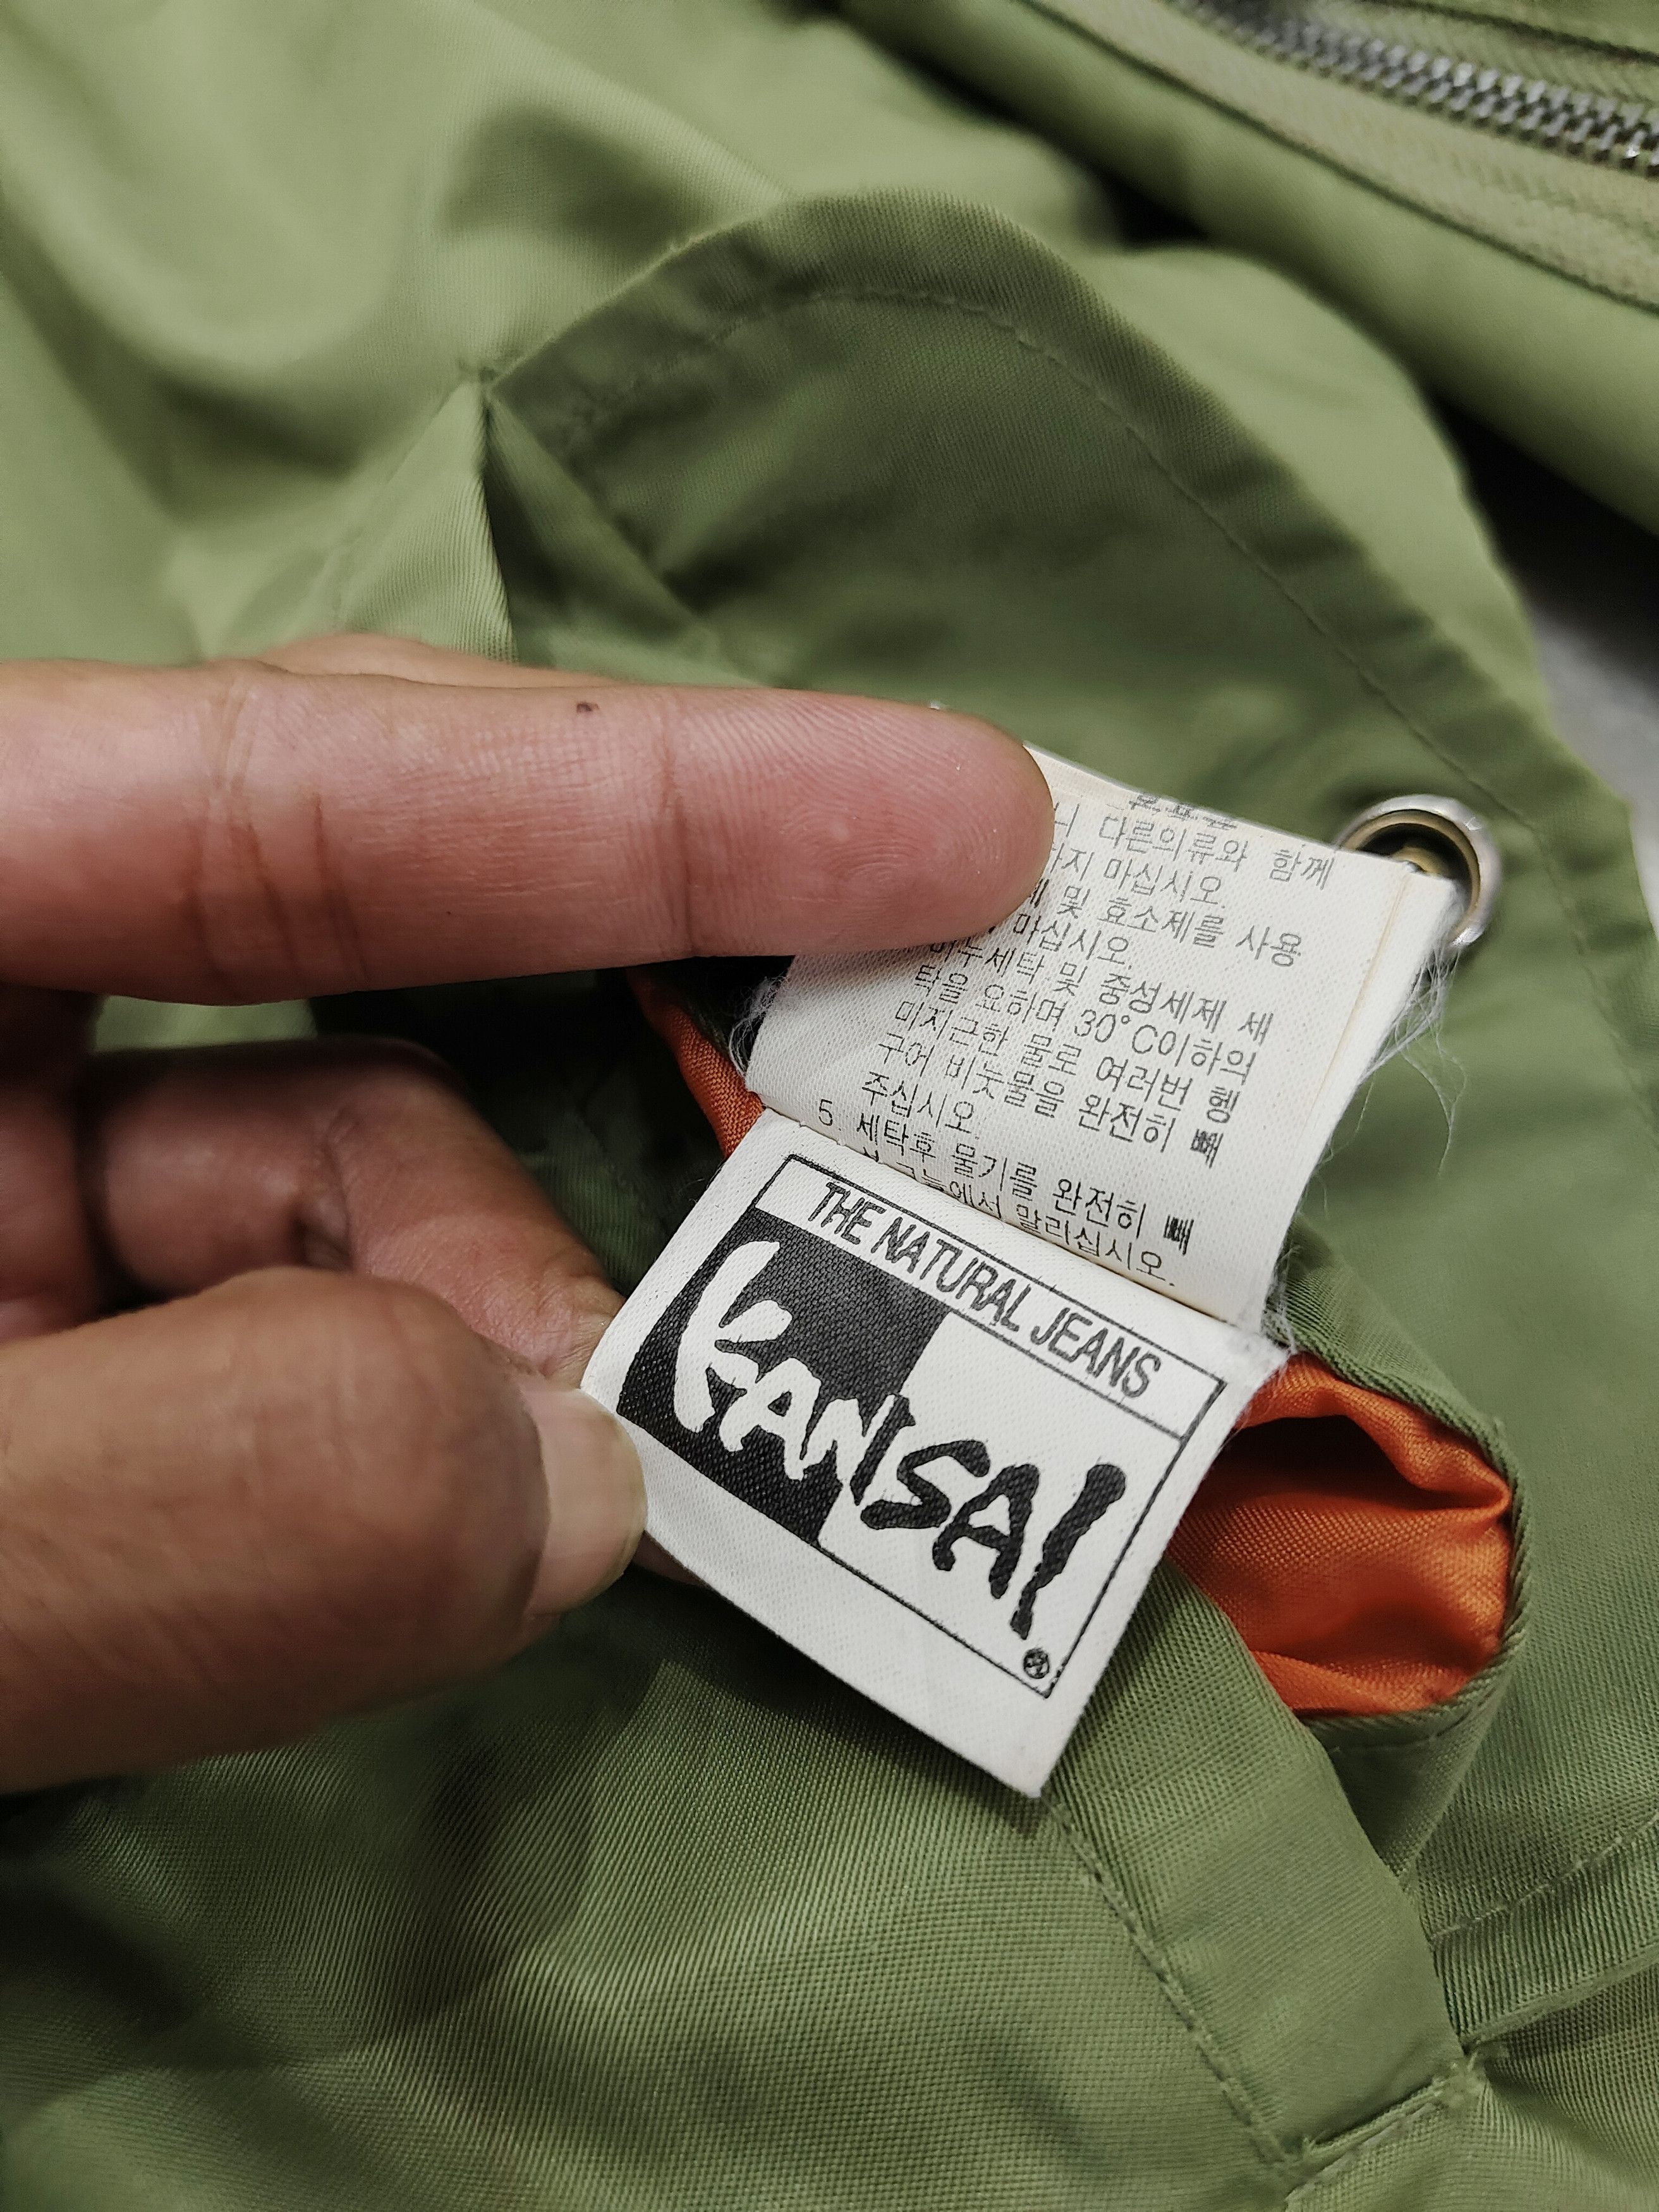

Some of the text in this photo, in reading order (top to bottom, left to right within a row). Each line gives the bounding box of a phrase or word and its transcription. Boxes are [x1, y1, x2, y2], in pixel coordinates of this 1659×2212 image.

[1098, 813, 1249, 873] 다른의류와
[1268, 843, 1335, 890] 함께
[1103, 857, 1227, 909] 마십시오.
[1012, 913, 1133, 970] 마십시오.
[1057, 884, 1091, 920] 및
[1097, 897, 1225, 949] 효소제를
[1235, 925, 1303, 968] 사용
[915, 964, 969, 1005] 탁을
[975, 983, 1068, 1033] 요하며
[1053, 961, 1088, 997] 및
[1098, 973, 1227, 1034] 중성세제
[1237, 1012, 1274, 1047] 세
[877, 1031, 935, 1078] 구어
[945, 1053, 1066, 1119] 비눗물을
[1078, 1094, 1177, 1153] 완전히
[894, 1000, 1010, 1057] 미지근한
[1020, 1033, 1082, 1076] 물로
[1096, 1056, 1194, 1112] 여러번
[861, 1071, 980, 1140] 주십시오.
[856, 1113, 937, 1164] 세탁후
[951, 1143, 1038, 1201] 물기를
[1052, 1178, 1147, 1240] 완전히
[807, 1181, 1162, 1399] THE NATURAL JEANS
